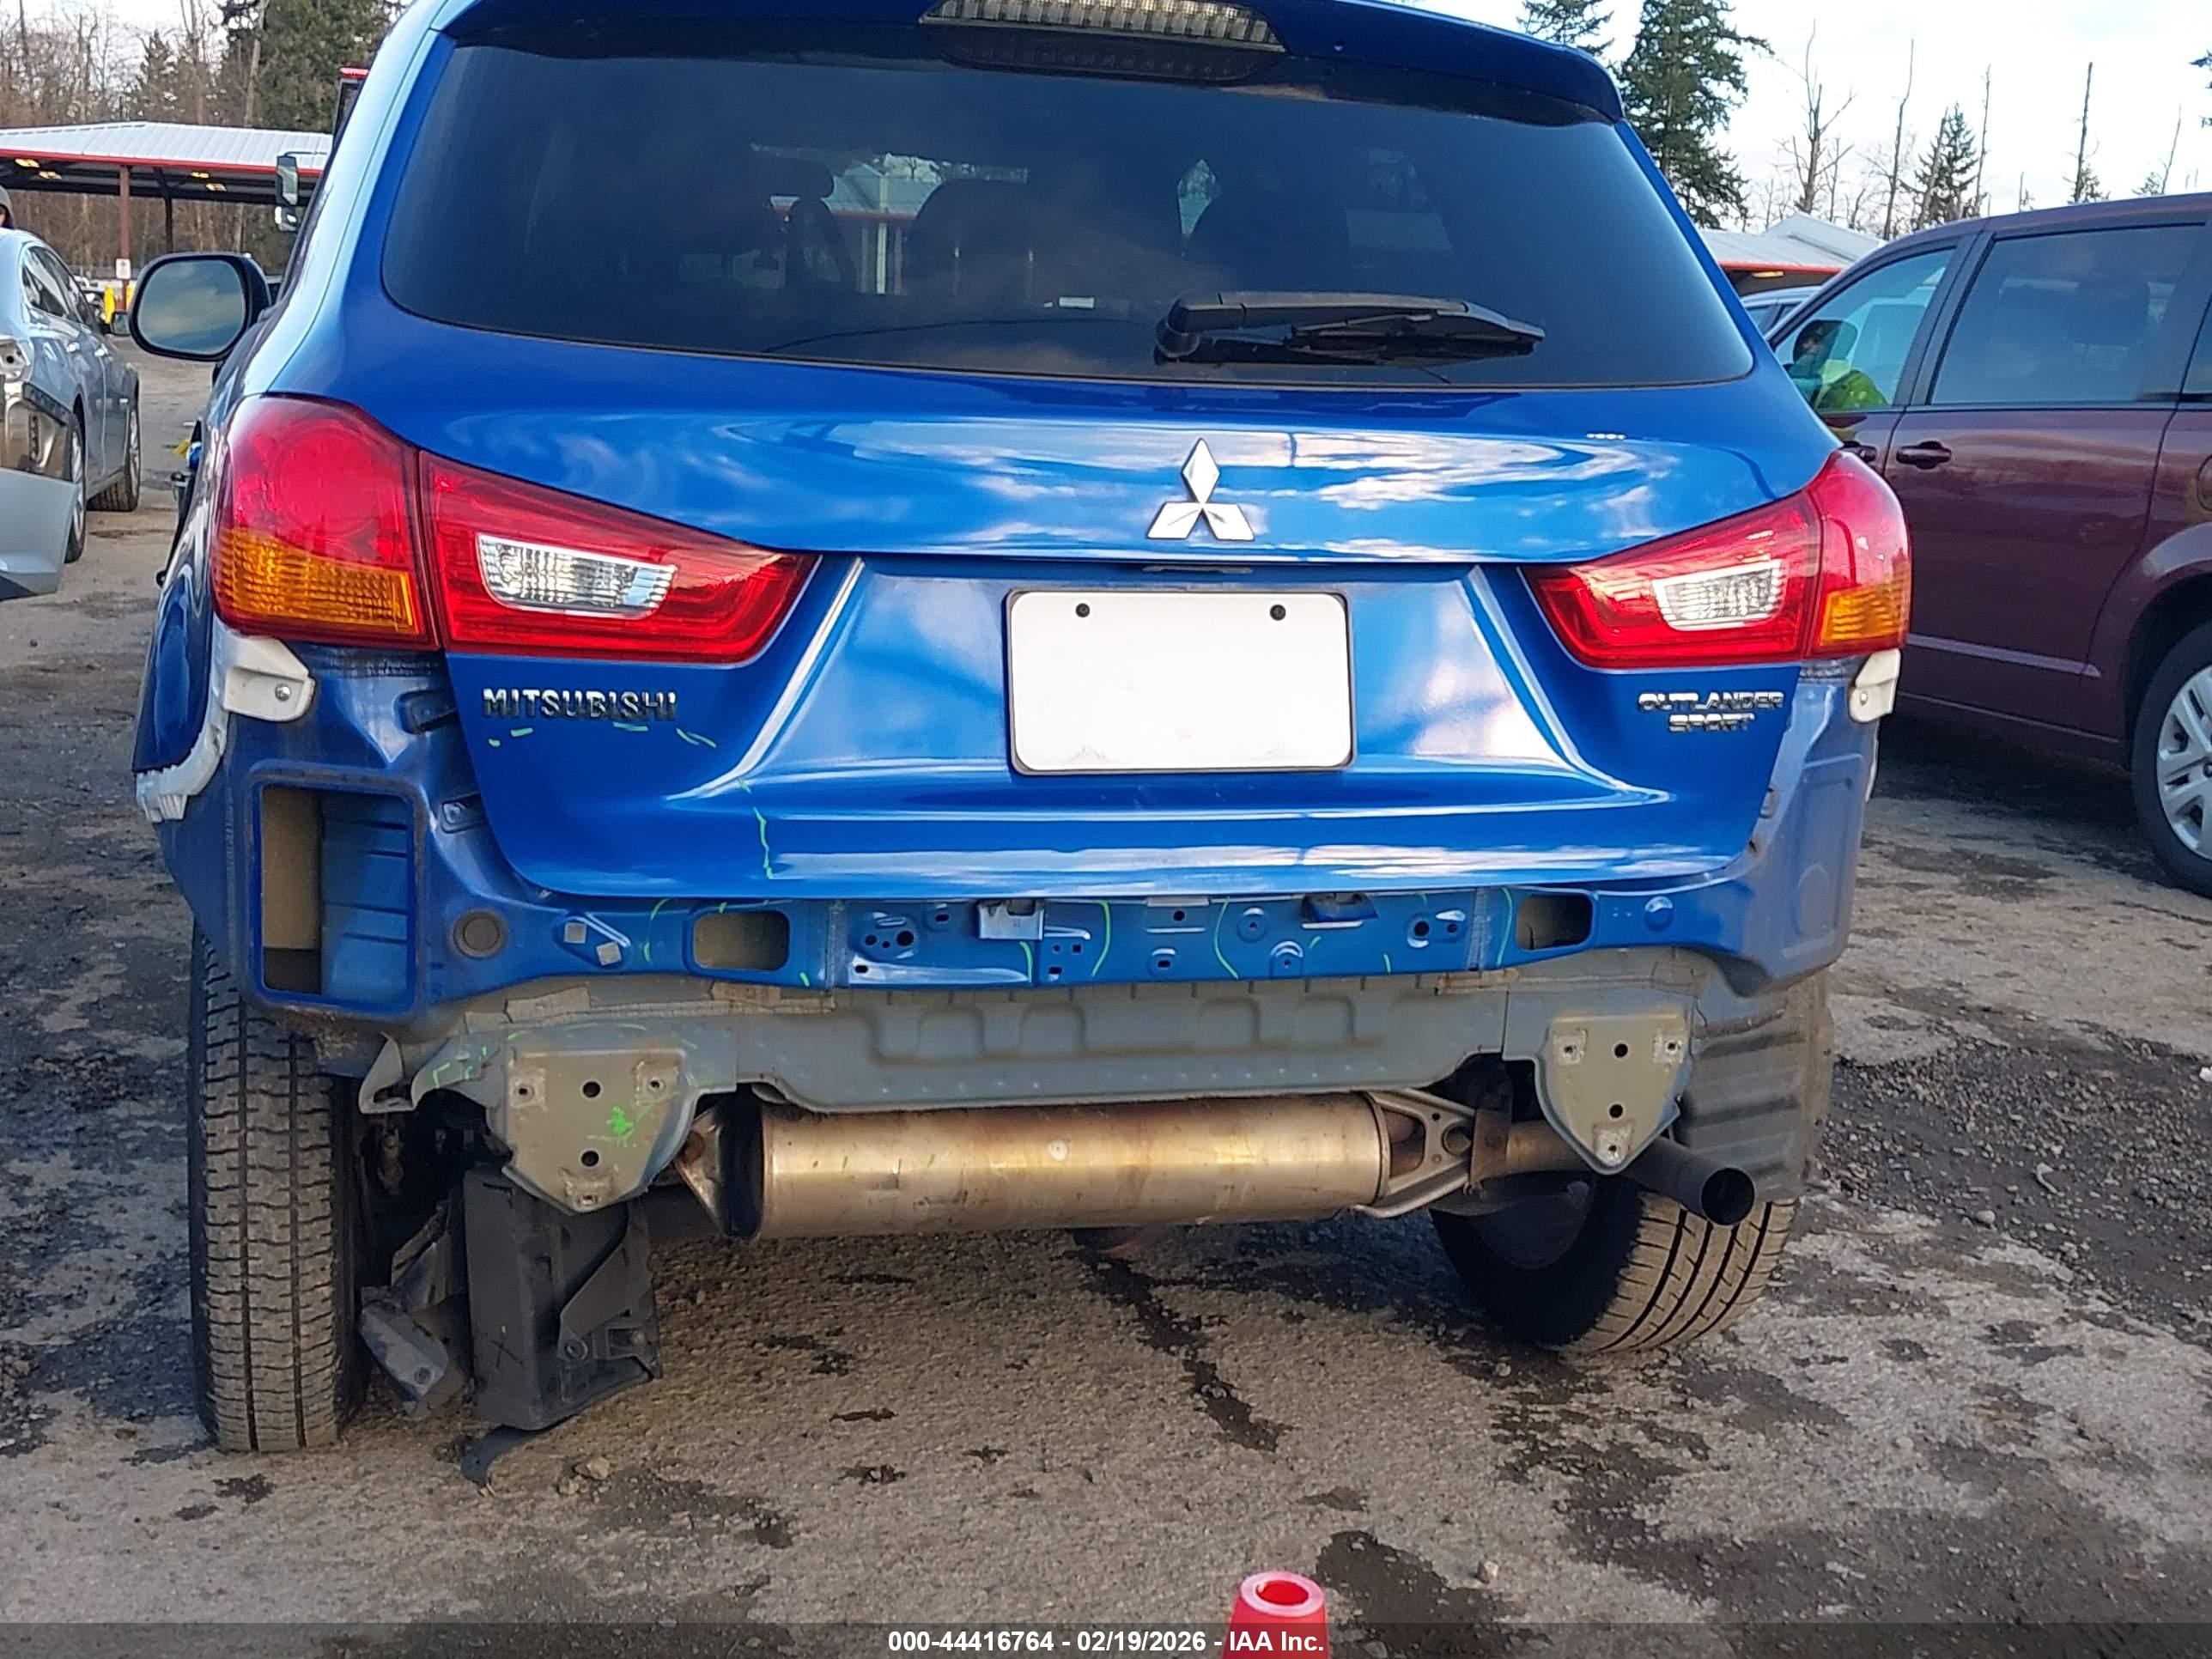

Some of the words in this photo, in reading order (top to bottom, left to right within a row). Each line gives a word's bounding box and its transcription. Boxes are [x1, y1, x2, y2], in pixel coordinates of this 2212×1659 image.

[483, 688, 677, 721] MITSUBISHI
[1638, 692, 1785, 711] OUTLANDER
[1668, 713, 1755, 732] SPORT
